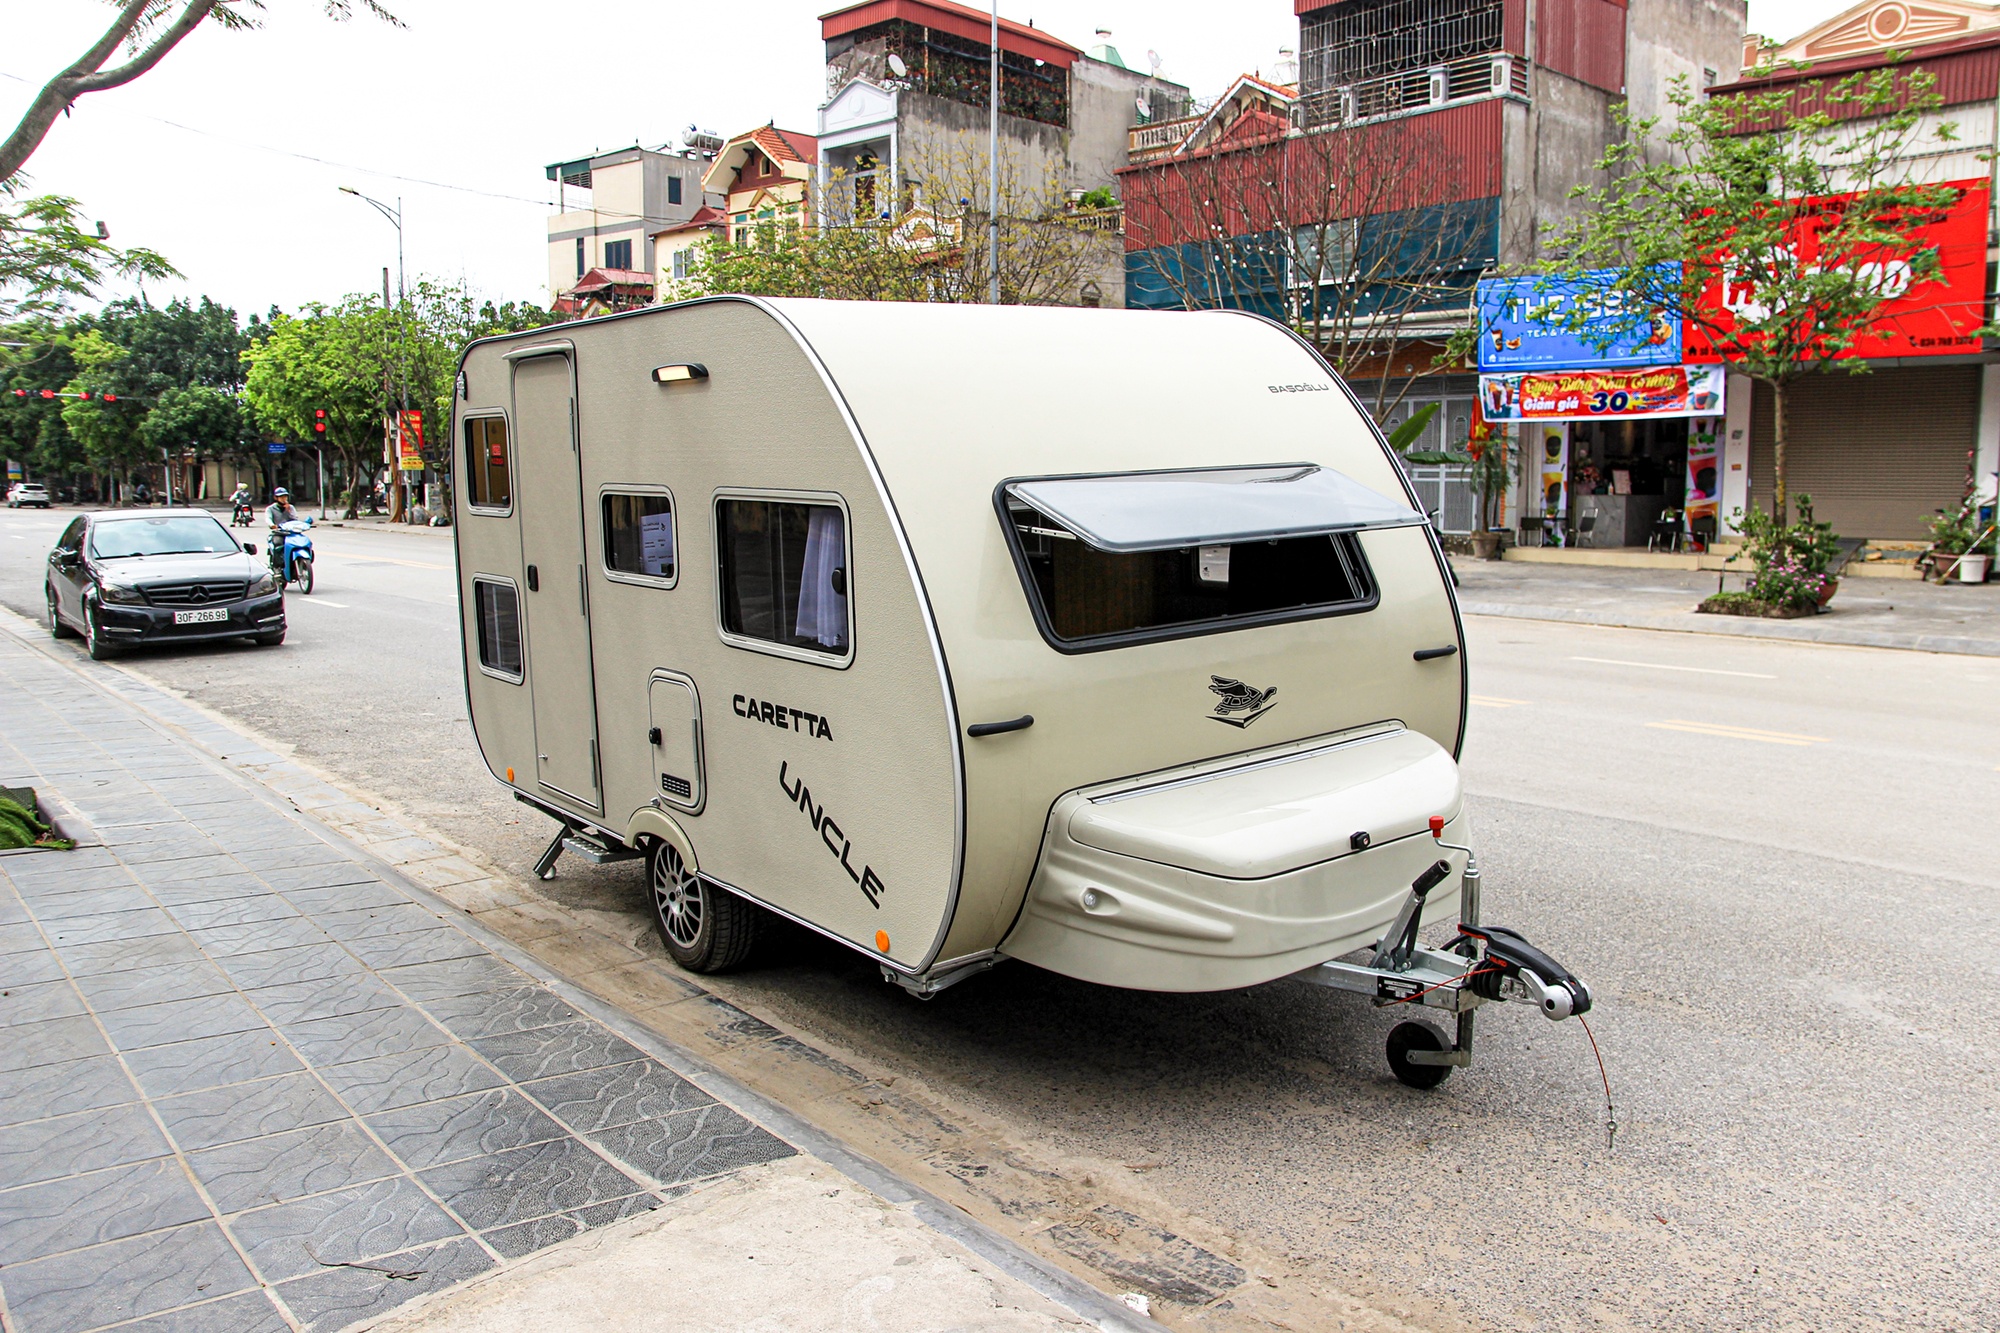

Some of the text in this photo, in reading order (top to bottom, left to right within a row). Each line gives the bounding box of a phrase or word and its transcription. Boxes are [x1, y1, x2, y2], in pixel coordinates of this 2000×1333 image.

[1527, 329, 1548, 338] TEA
[1549, 329, 1558, 338] &
[1557, 395, 1580, 412] giá
[733, 693, 834, 742] CARETTA
[779, 760, 885, 910] UNCLE
